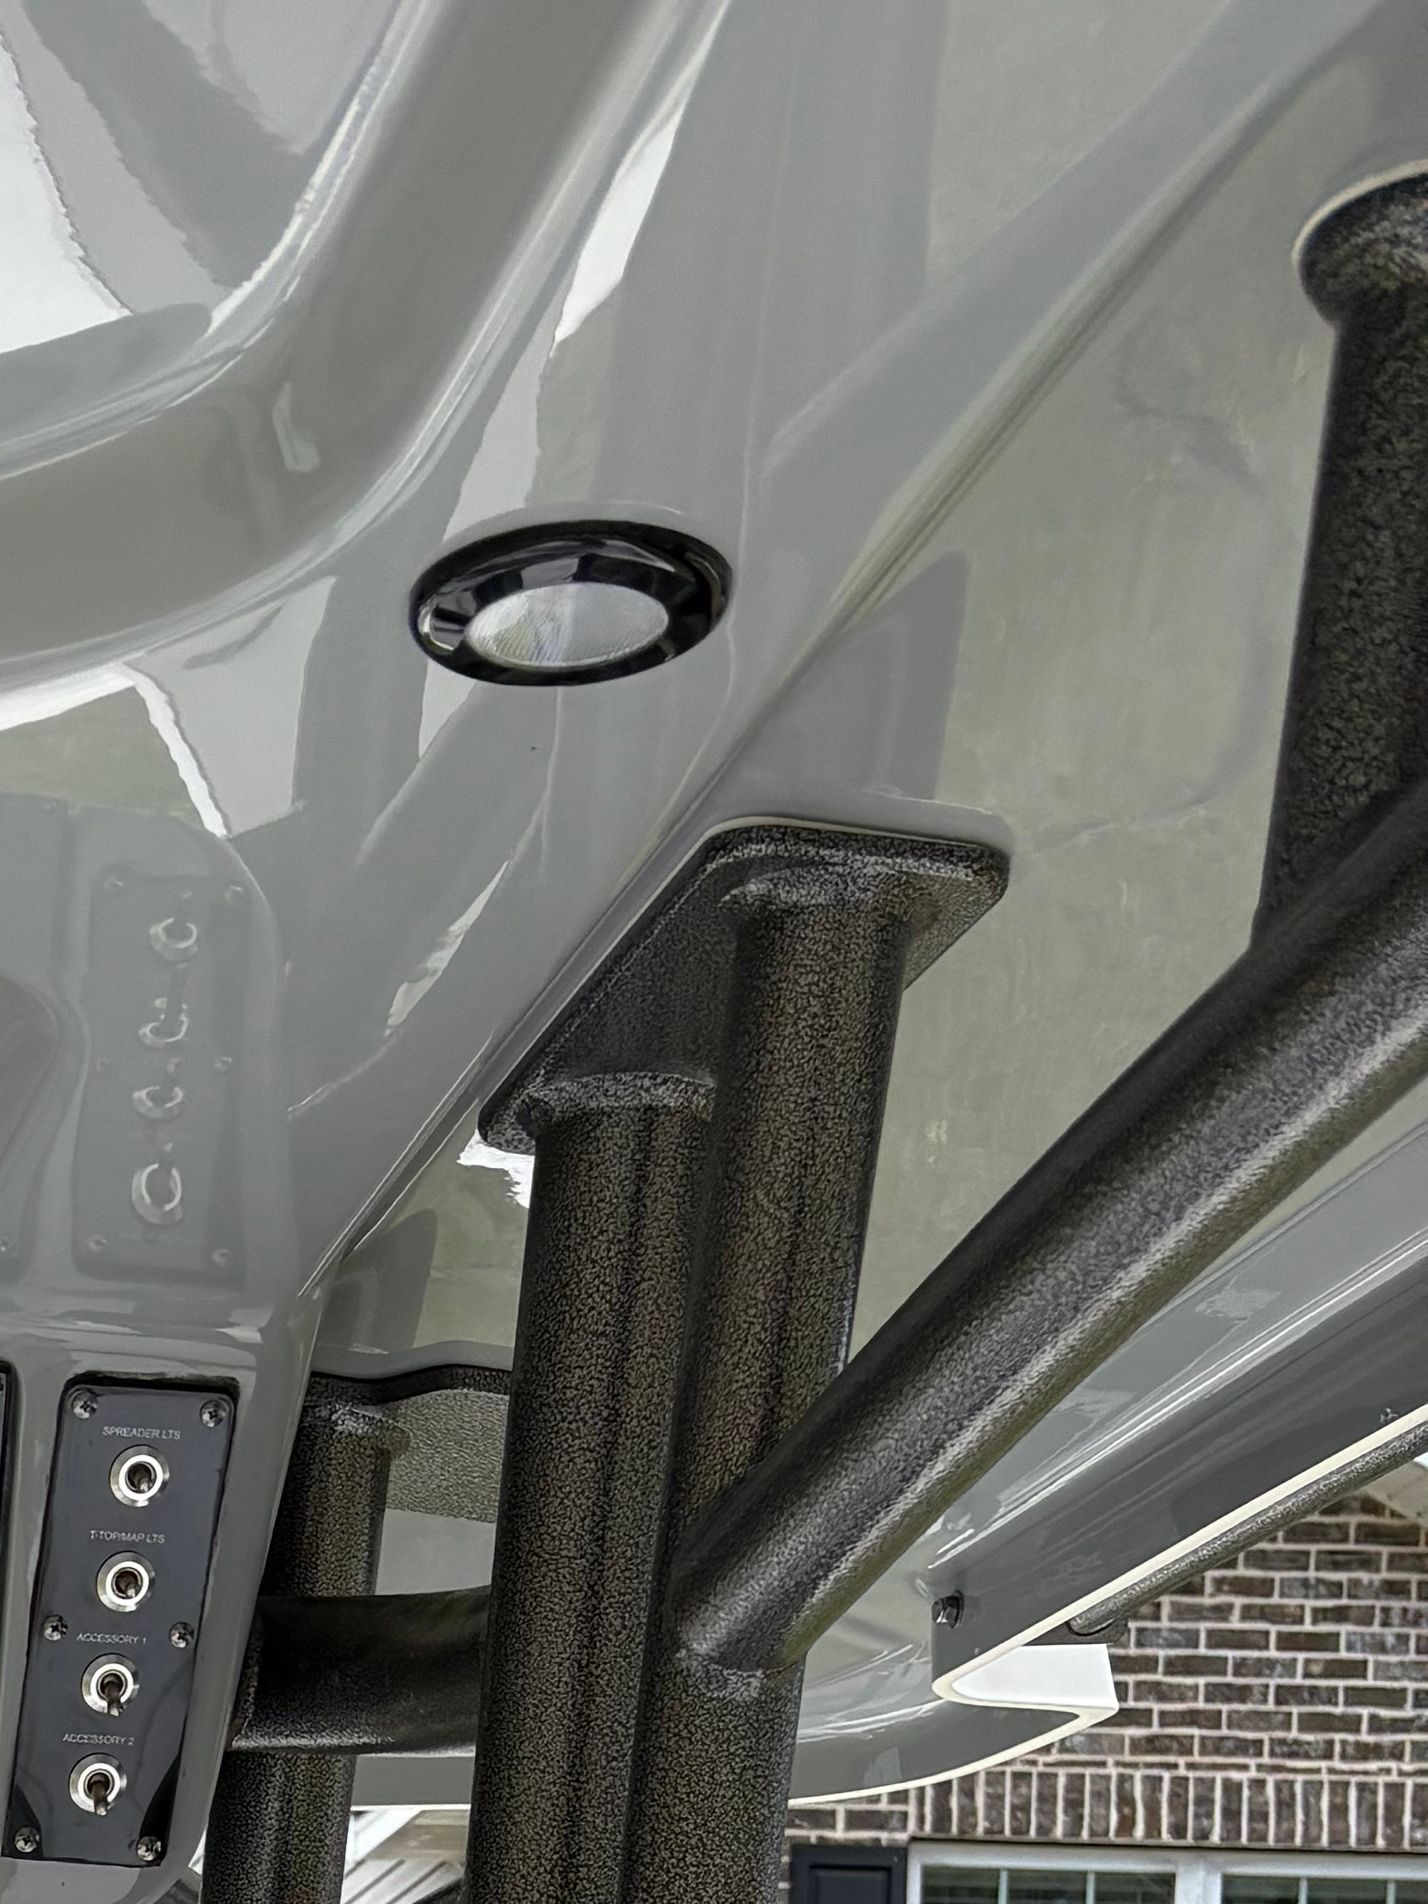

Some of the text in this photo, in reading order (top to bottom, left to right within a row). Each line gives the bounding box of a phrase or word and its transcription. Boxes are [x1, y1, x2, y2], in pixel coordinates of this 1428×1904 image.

[102, 1426, 181, 1440] SPREADER LTS
[146, 1534, 165, 1544] LTS
[76, 1632, 140, 1644] ACCESSORY
[63, 1734, 134, 1745] ACCESSORY 2
